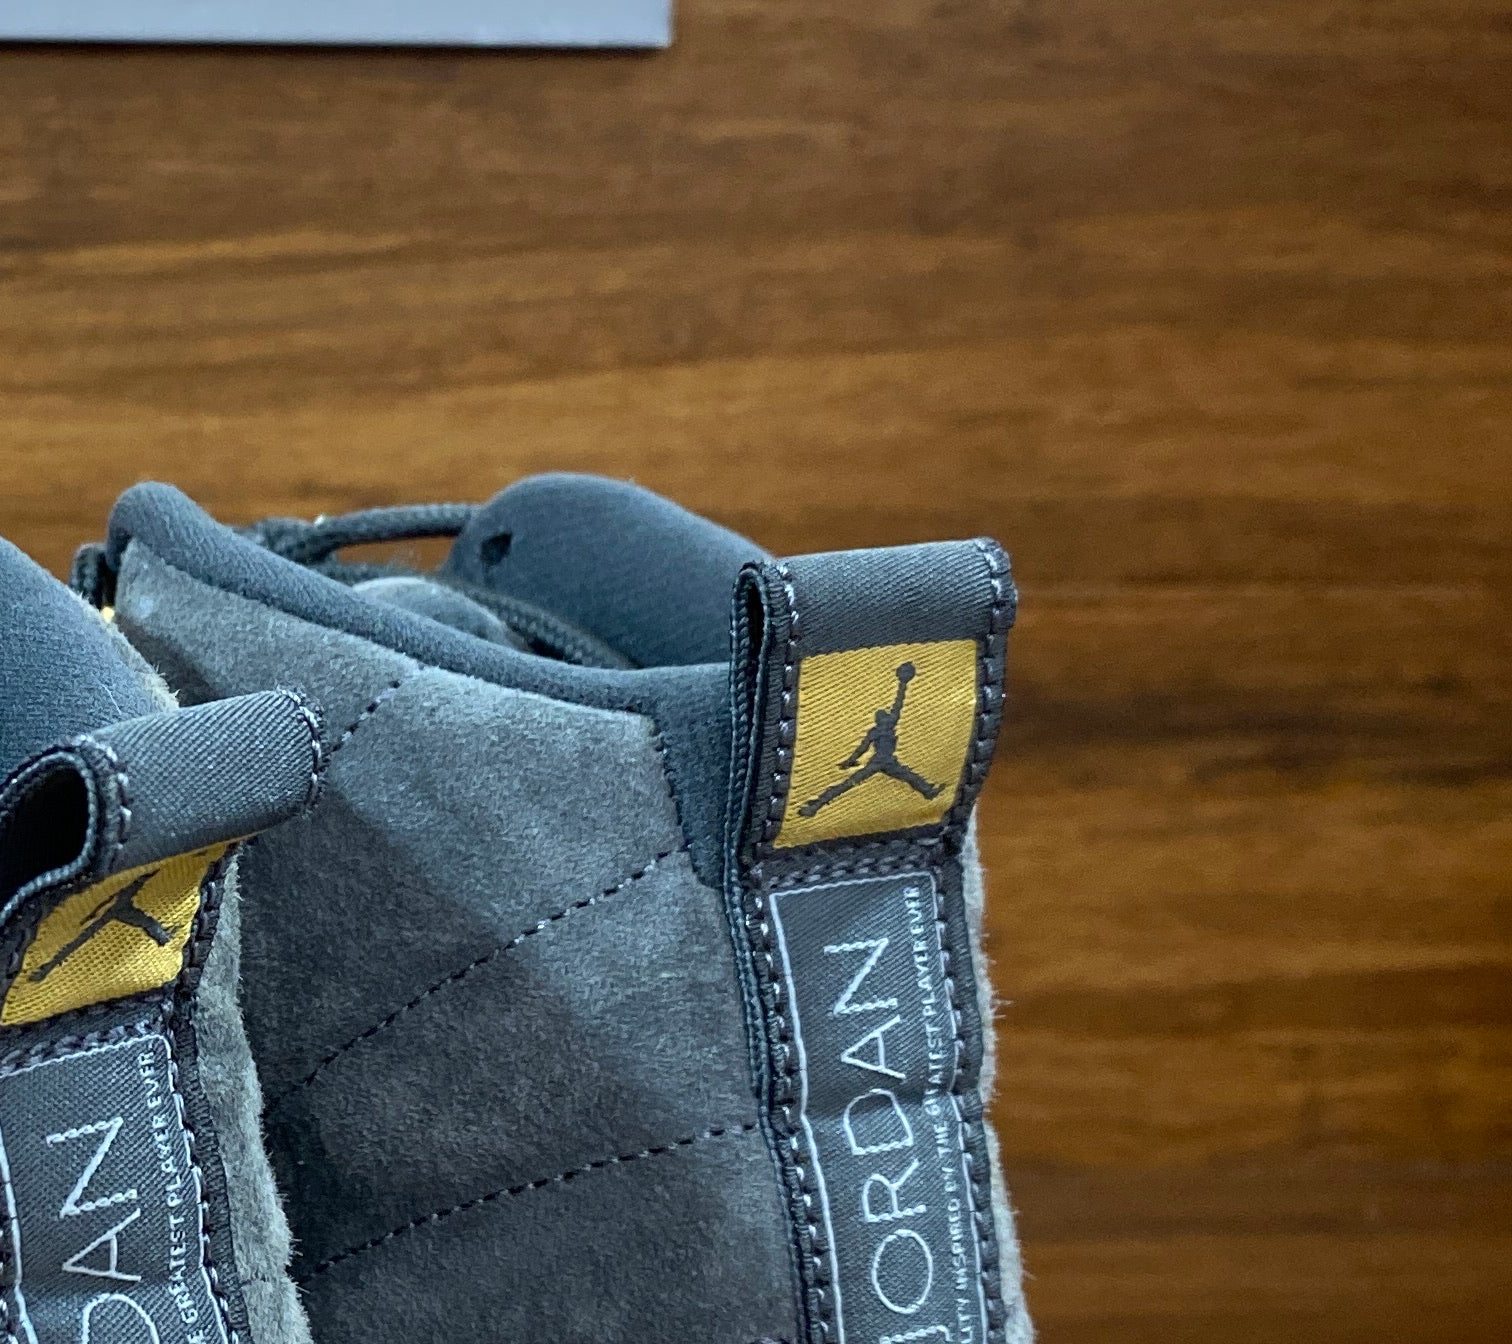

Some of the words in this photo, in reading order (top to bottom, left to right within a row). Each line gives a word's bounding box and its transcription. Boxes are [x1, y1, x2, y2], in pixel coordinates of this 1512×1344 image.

[912, 939, 939, 1017] PLAYER
[152, 1112, 185, 1207] PLAYER
[824, 937, 953, 1344] JORDAN
[168, 1214, 199, 1324] GREATEST
